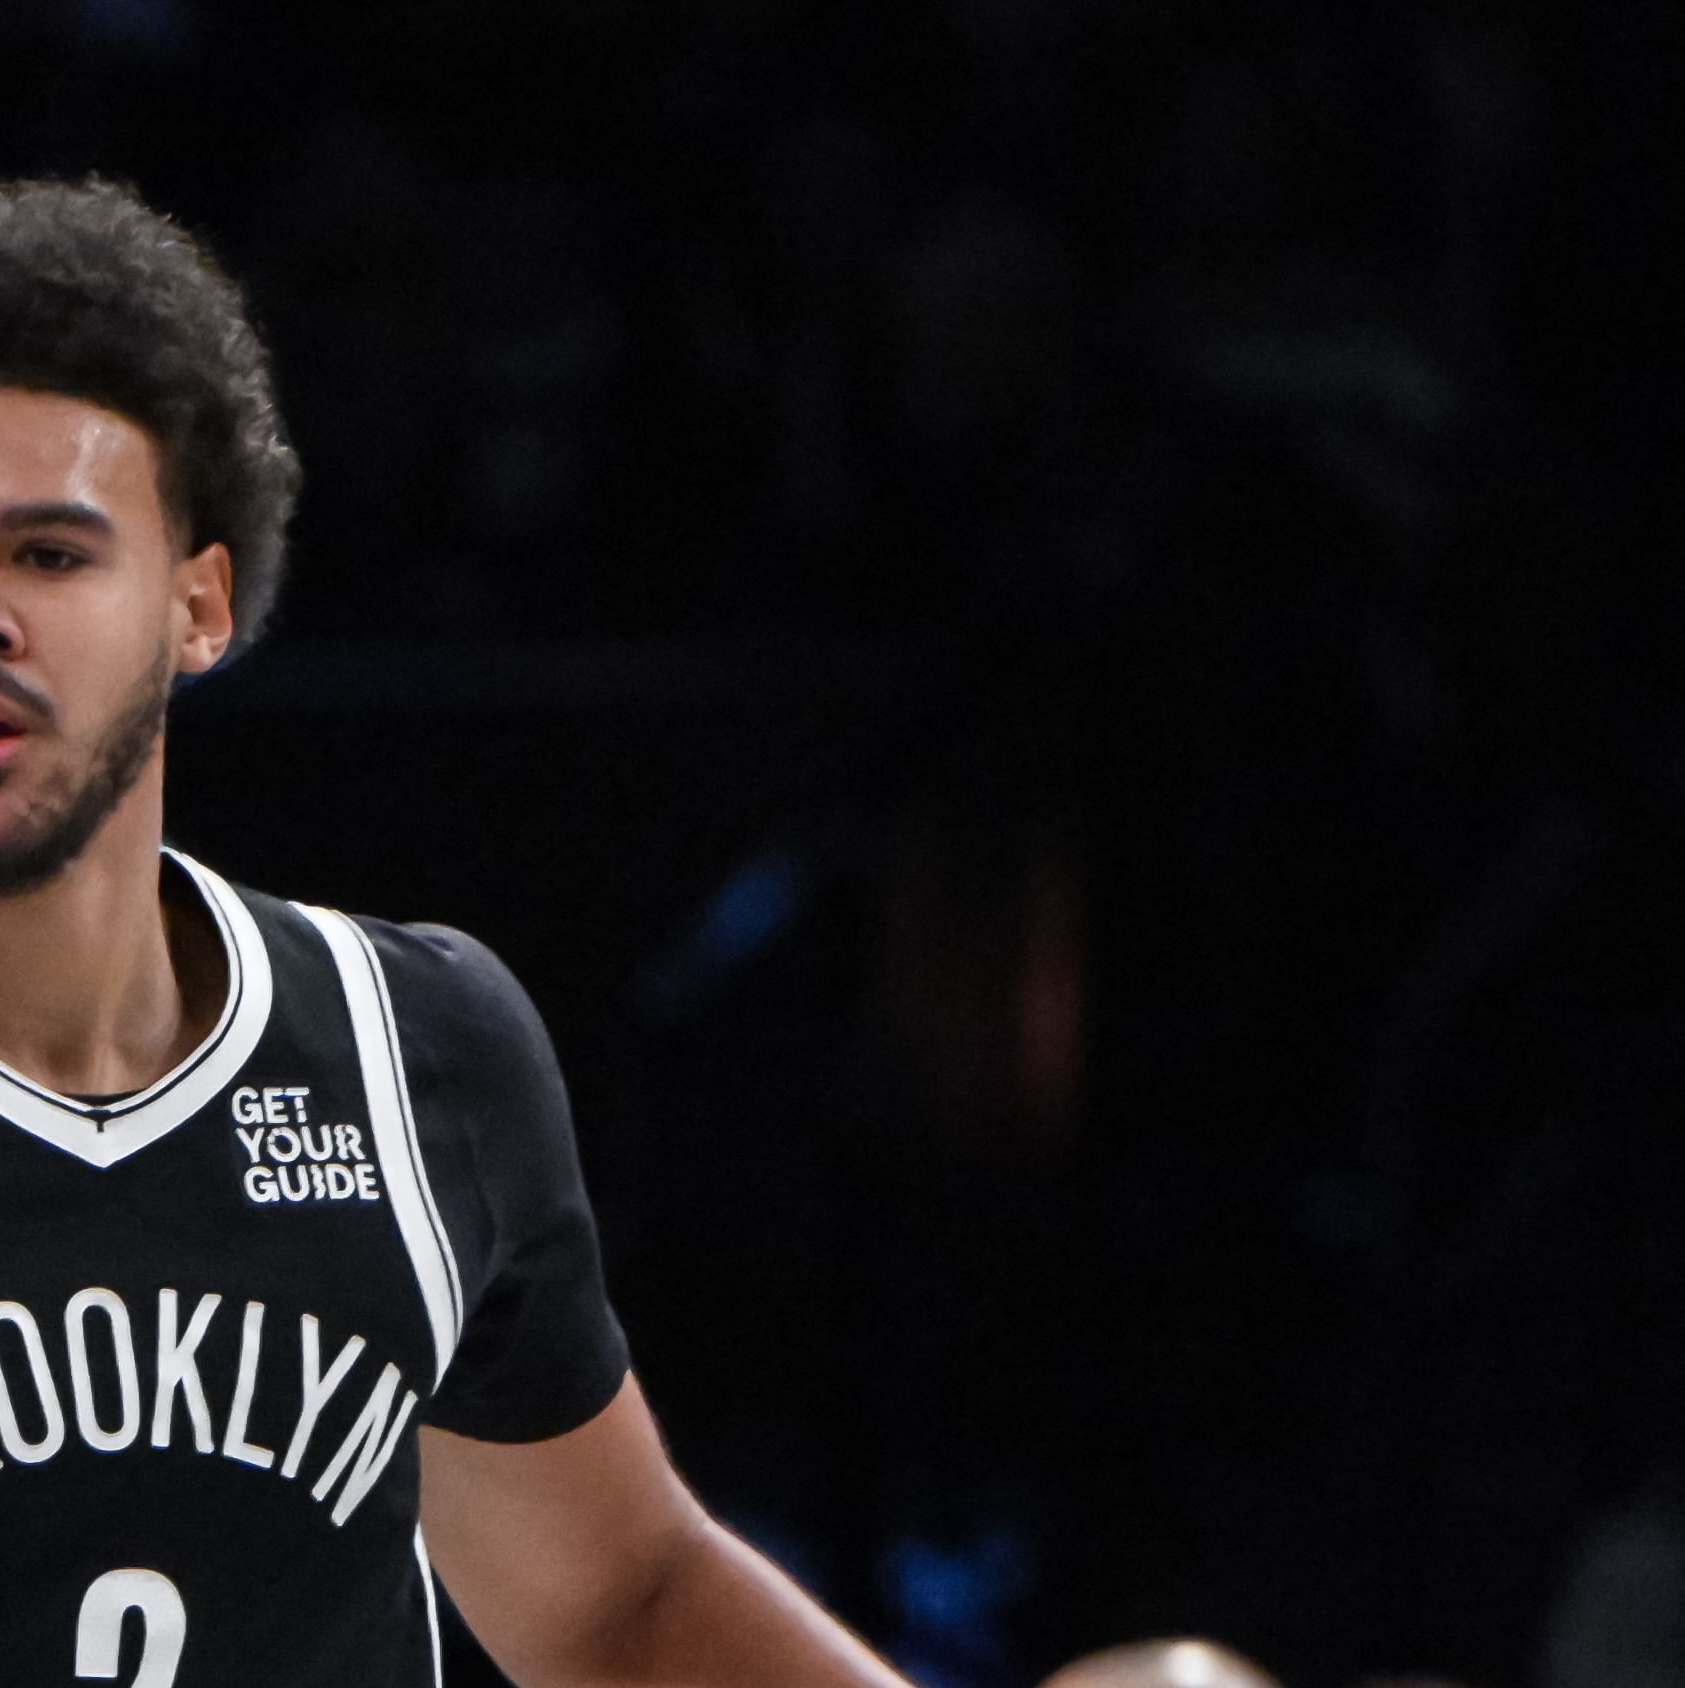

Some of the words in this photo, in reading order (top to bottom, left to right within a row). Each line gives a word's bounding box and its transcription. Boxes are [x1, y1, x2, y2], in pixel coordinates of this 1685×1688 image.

[231, 1086, 310, 1125] GET
[234, 1124, 366, 1163] YOUR
[244, 1163, 380, 1203] GUIDE
